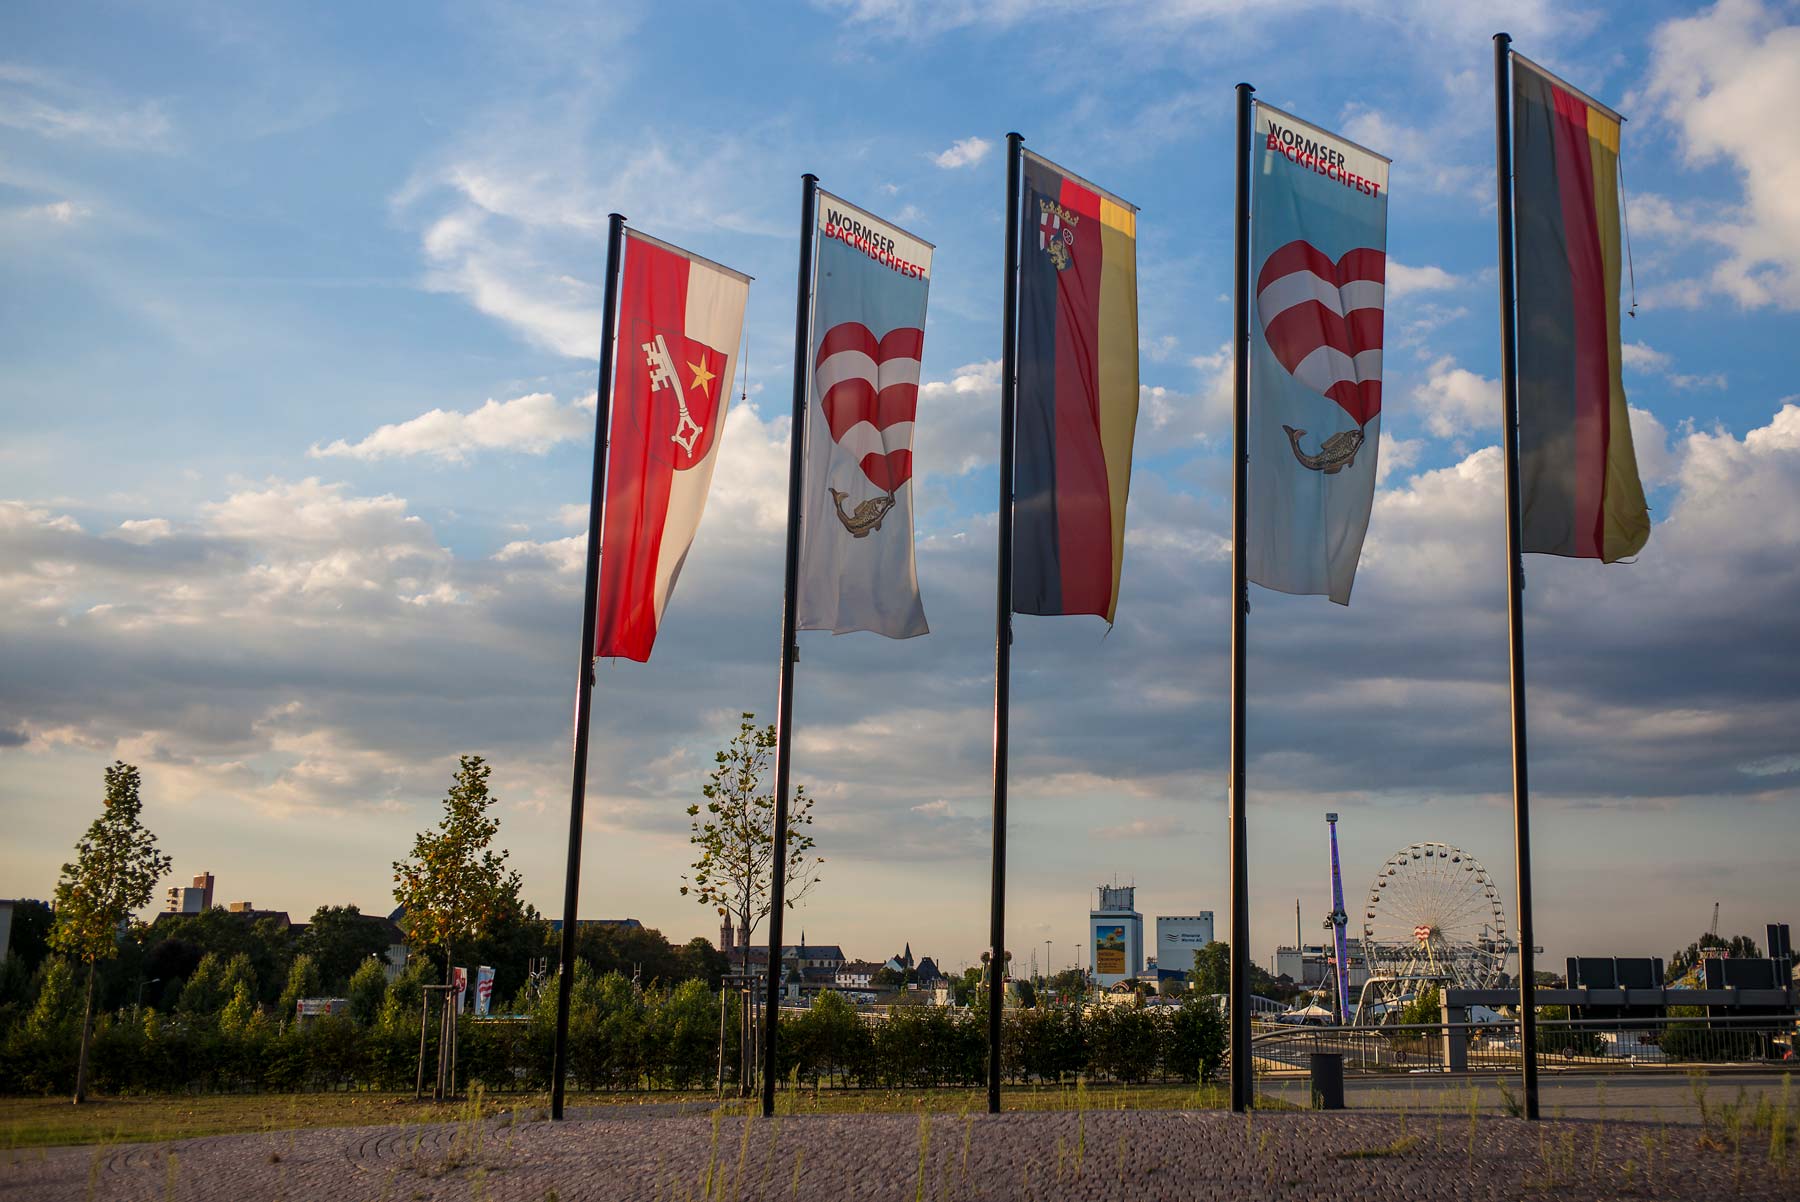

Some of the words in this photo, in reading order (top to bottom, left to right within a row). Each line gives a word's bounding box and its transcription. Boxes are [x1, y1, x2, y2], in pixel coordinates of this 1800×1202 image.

[1267, 134, 1380, 198] BACKFISCHFEST
[1268, 120, 1345, 170] WORMSER
[825, 222, 925, 280] BACKFISCHFEST
[827, 208, 895, 255] WORMSER
